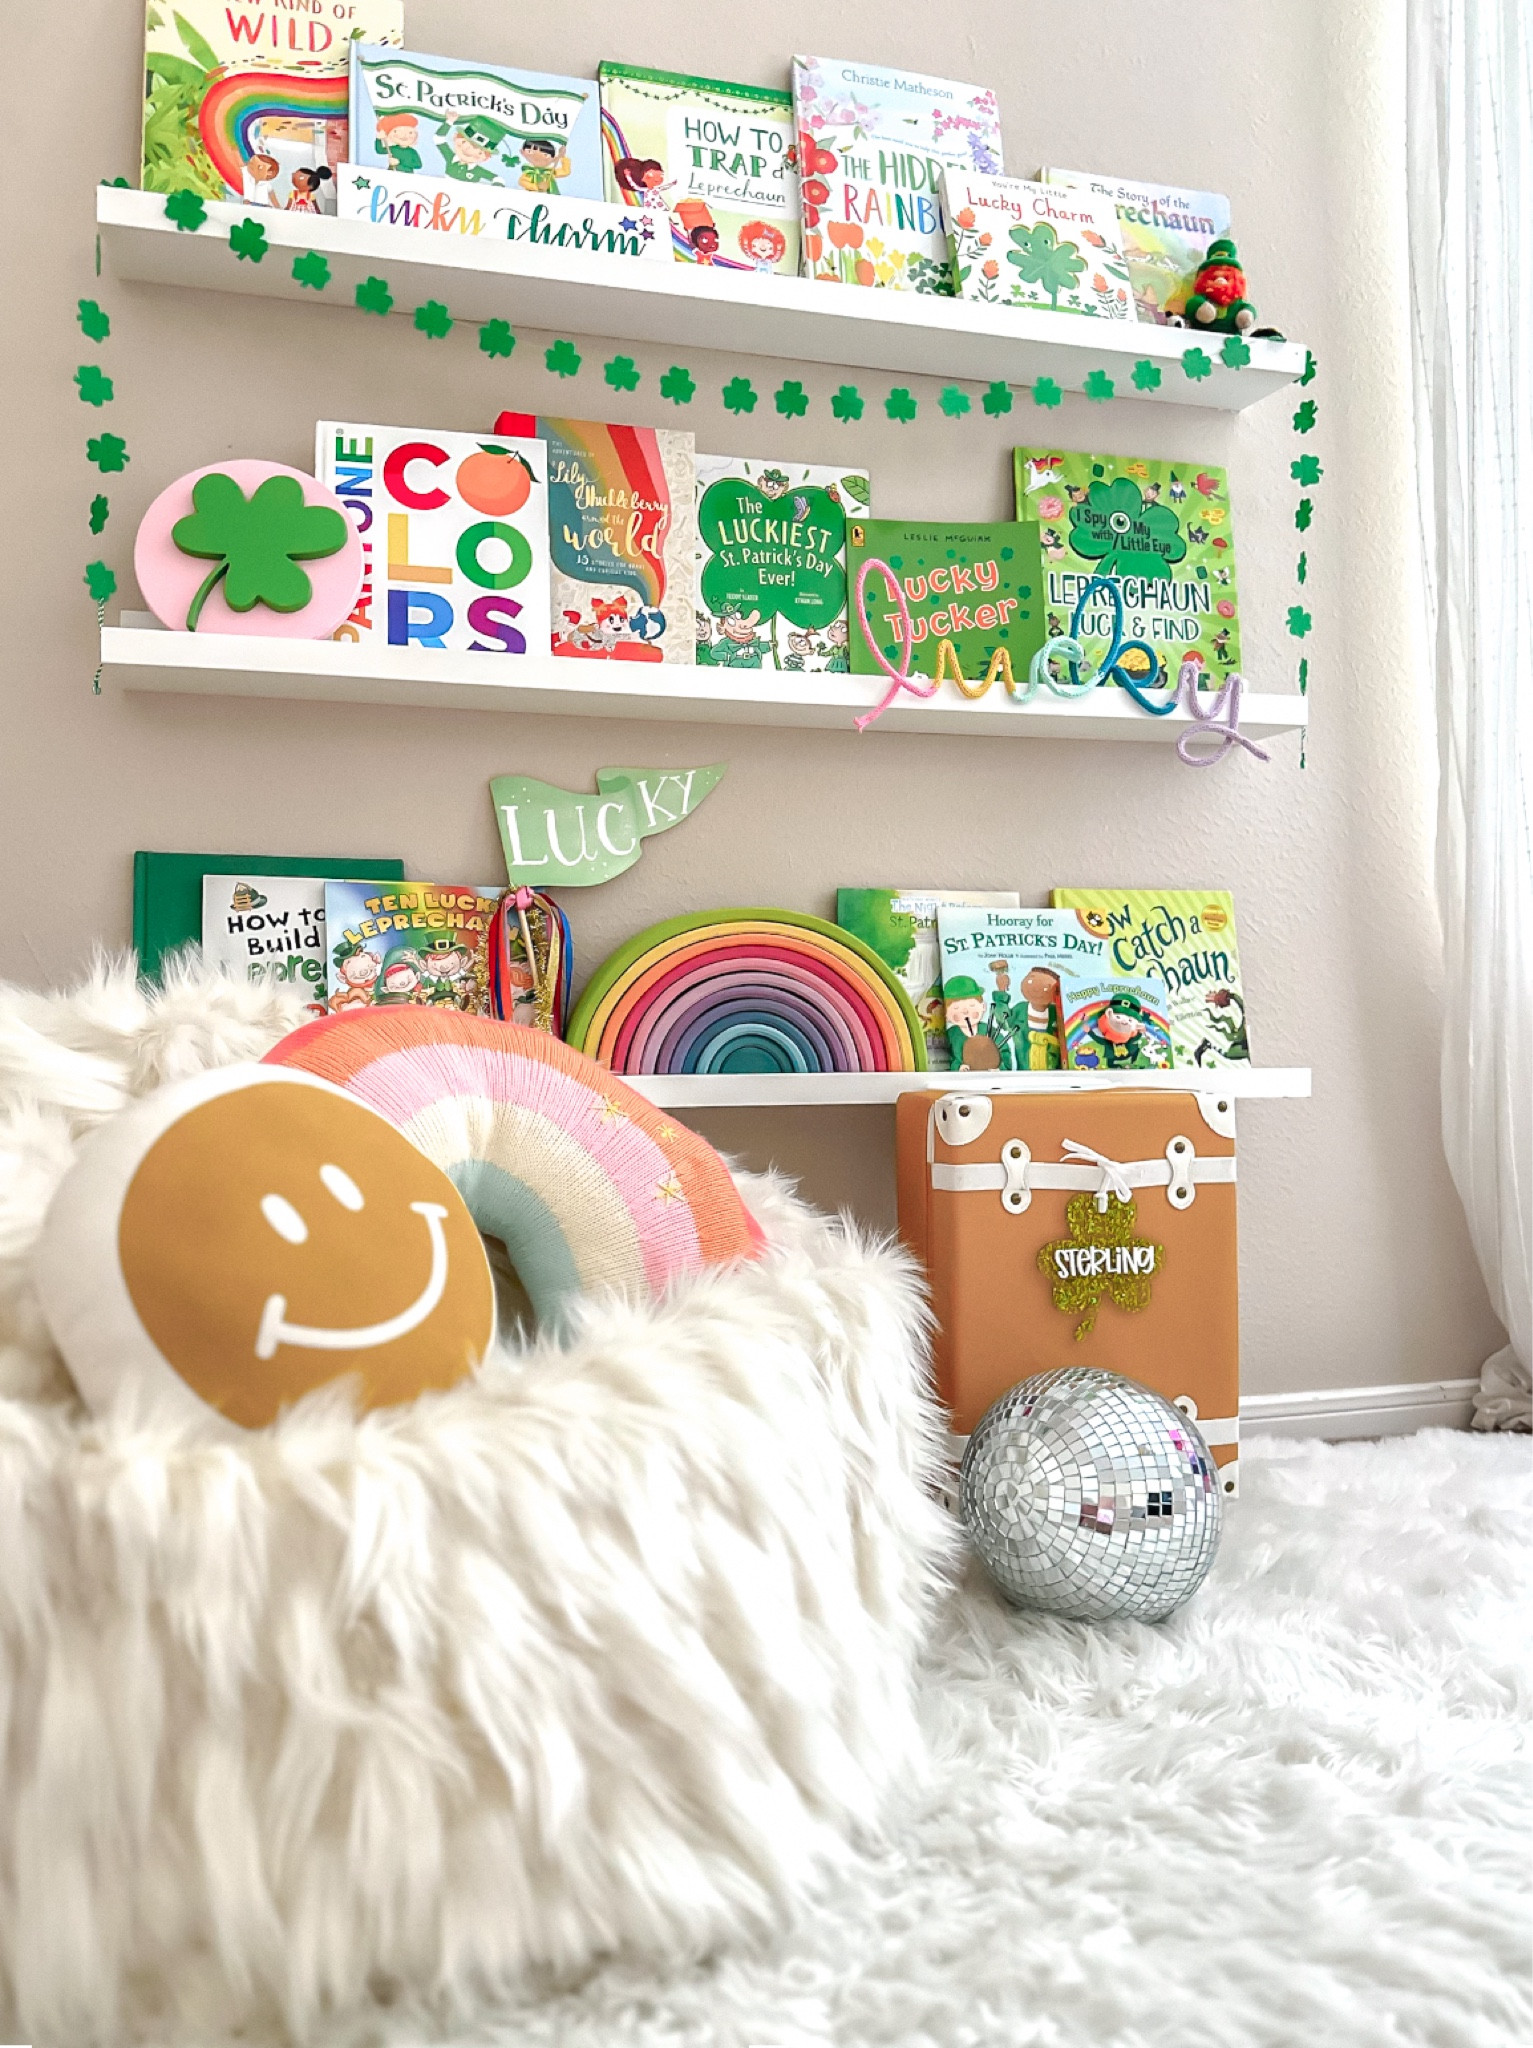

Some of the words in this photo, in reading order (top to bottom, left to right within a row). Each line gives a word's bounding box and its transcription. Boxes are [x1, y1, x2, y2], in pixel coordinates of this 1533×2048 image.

[333, 4, 357, 19] OF
[225, 7, 333, 52] WILD
[841, 69, 891, 89] Christie
[893, 78, 954, 100] Matheson
[520, 102, 568, 130] Day
[684, 116, 741, 147] HOW
[749, 128, 783, 154] TO
[685, 144, 768, 179] TRAP
[840, 155, 873, 181] THE
[878, 150, 970, 195] HIDD
[687, 171, 786, 204] Leprechaun
[991, 180, 1020, 191] You're
[1023, 185, 1037, 195] My
[1039, 187, 1068, 200] Little
[1089, 182, 1114, 199] The
[1116, 186, 1150, 207] Story
[1159, 194, 1173, 208] of
[1175, 197, 1191, 210] the
[966, 186, 1023, 221] Lucky
[1032, 198, 1095, 225] Charm
[493, 203, 647, 257] charm
[549, 461, 600, 500] Lily
[575, 485, 669, 531] Huckleberry
[736, 496, 763, 514] The
[1076, 509, 1081, 522] I
[1084, 509, 1107, 527] Spy
[333, 436, 373, 643] PAONE
[562, 510, 662, 560] world
[717, 518, 833, 553] LUCKIEST
[904, 533, 939, 542] LESLIE
[1091, 530, 1114, 541] with
[1133, 521, 1151, 538] My
[576, 554, 589, 566] 15
[1120, 536, 1150, 551] Little
[1152, 540, 1172, 556] Eye
[719, 549, 741, 568] St.
[742, 547, 802, 568] Patrick's
[805, 552, 834, 579] Day
[758, 568, 796, 587] Ever!
[1048, 572, 1212, 613] LEPRECHAUN
[882, 598, 1018, 644] Tucker
[1131, 615, 1146, 637] &
[1152, 617, 1200, 641] FIND
[500, 769, 697, 867] LUCKY
[365, 894, 419, 916] TEN
[424, 892, 494, 914] LUCK
[890, 899, 913, 915] The
[343, 912, 485, 946] LEPRECHA
[889, 915, 907, 929] St.
[909, 915, 938, 930] Patr
[987, 913, 1033, 930] Hooray
[1036, 914, 1054, 927] for
[248, 926, 320, 956] Build
[1112, 905, 1187, 972] Catch
[1189, 915, 1203, 935] a
[1066, 984, 1101, 1004] Happy
[1100, 982, 1161, 1007] Leprechaun
